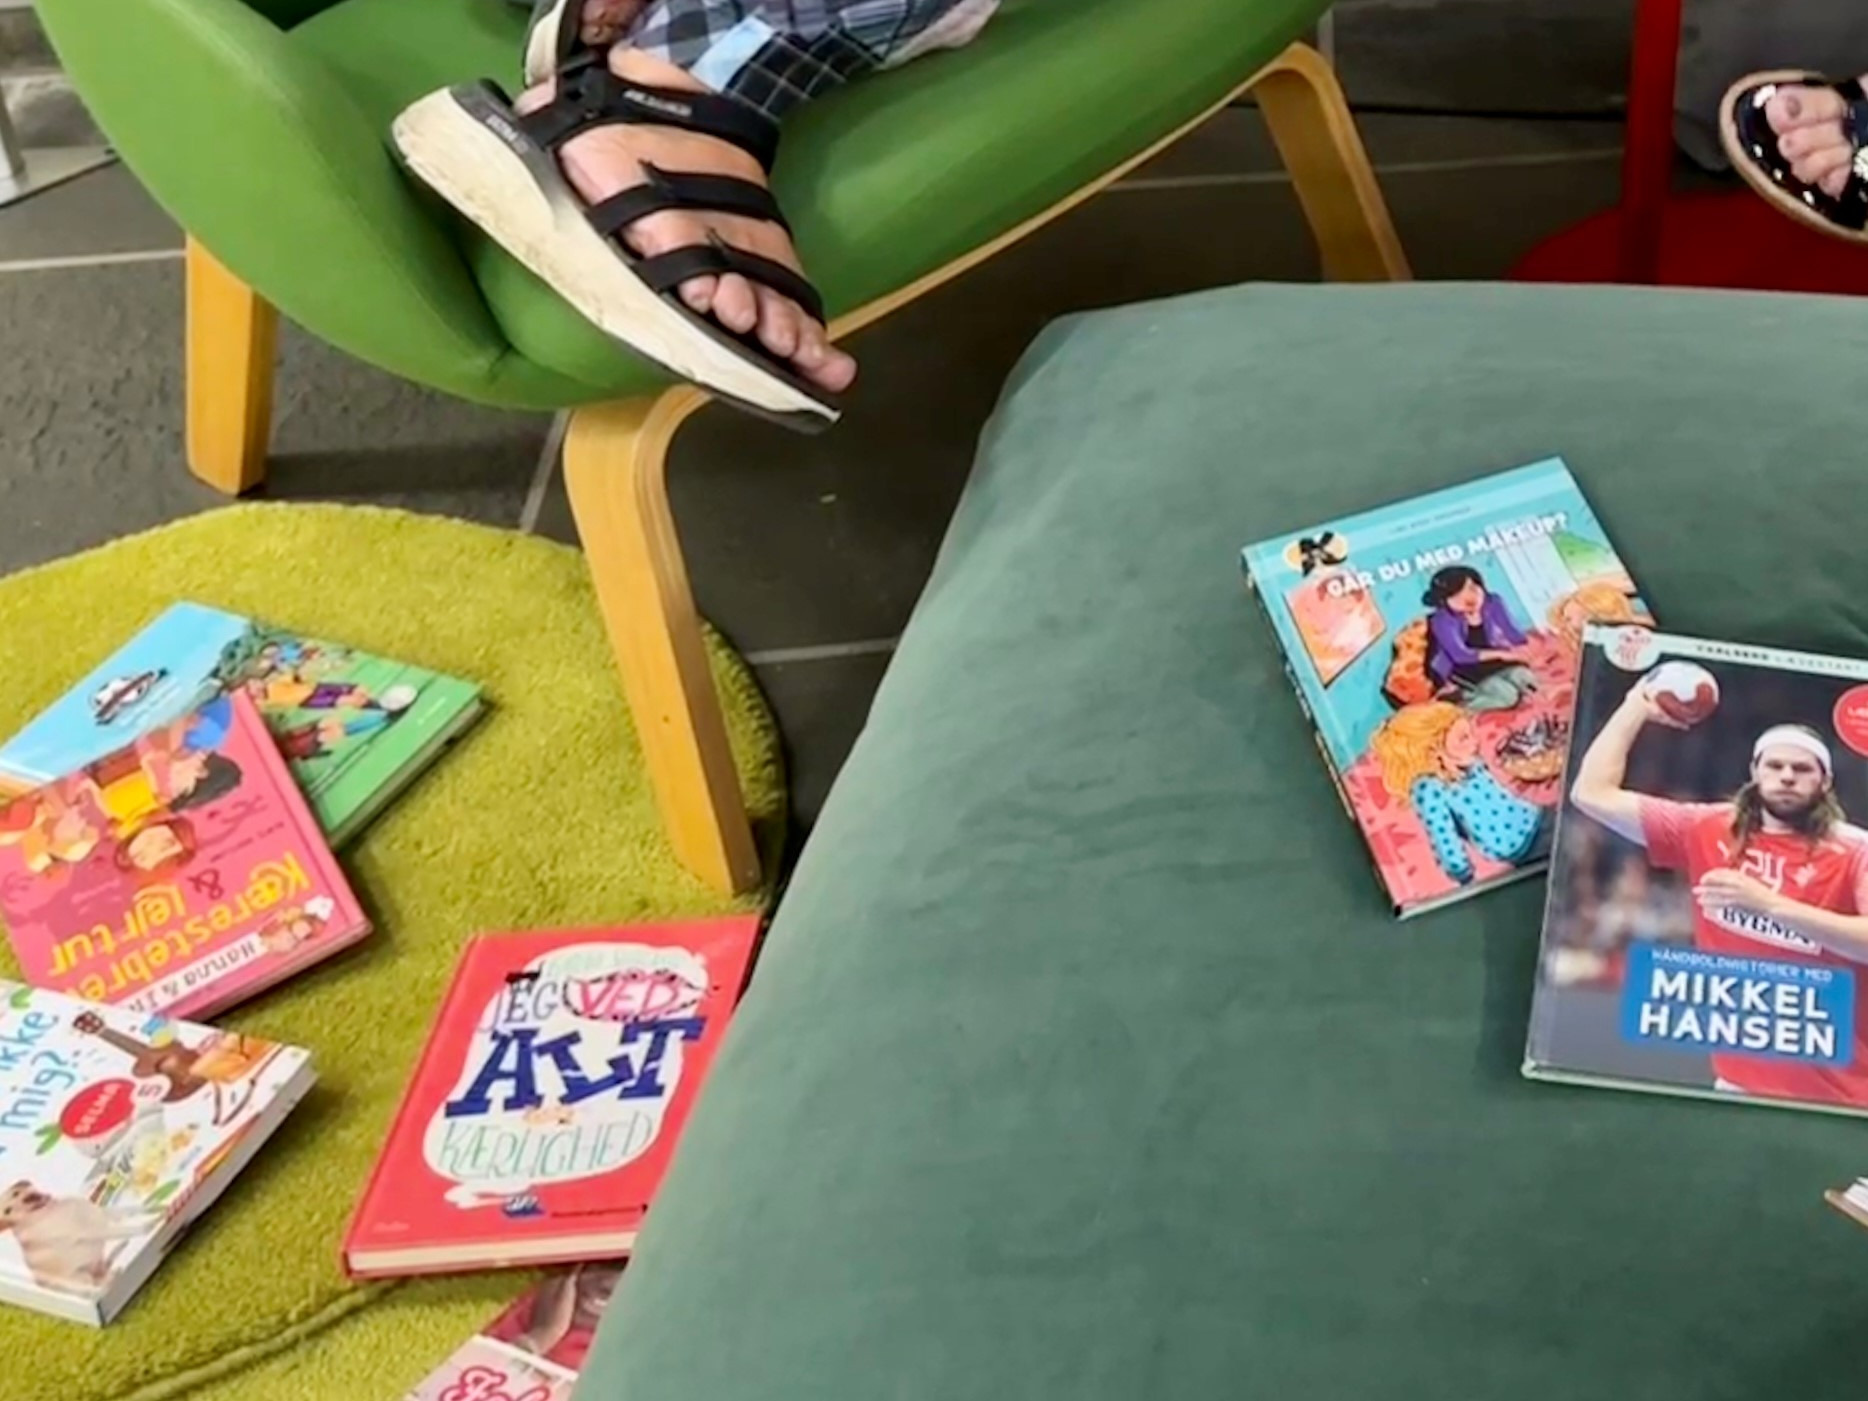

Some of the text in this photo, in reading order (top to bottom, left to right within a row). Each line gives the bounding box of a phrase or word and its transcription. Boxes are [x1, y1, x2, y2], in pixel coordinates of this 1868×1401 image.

[1378, 562, 1412, 583] DU
[1414, 544, 1465, 573] MED
[187, 867, 225, 901] &
[65, 851, 311, 1000] Kærestebre
[477, 971, 680, 1033] JEG VED
[1651, 968, 1829, 1020] MIKKEL
[1804, 969, 1833, 983] MED
[1639, 1002, 1836, 1058] HANSEN
[445, 1016, 708, 1118] ALT
[440, 1110, 654, 1179] KÆRLIGHED
